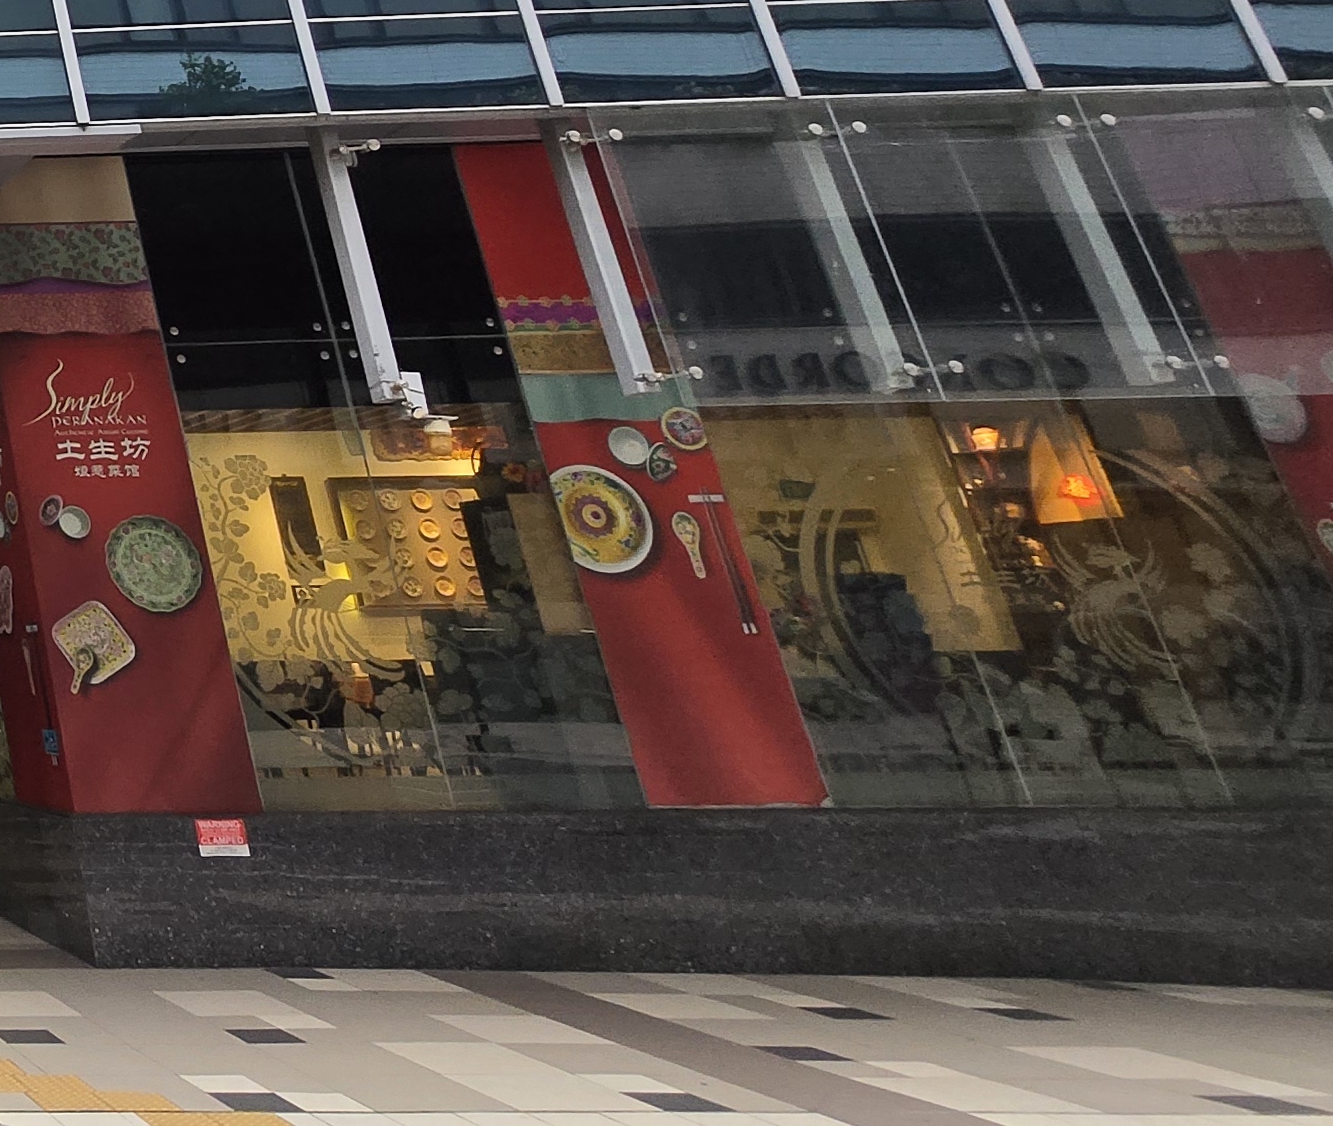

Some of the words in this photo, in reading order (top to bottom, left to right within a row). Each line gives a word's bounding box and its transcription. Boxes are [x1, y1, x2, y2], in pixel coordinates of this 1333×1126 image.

[21, 358, 135, 426] Simply
[51, 414, 148, 429] PERANAKAN
[55, 436, 151, 461] 土生坊
